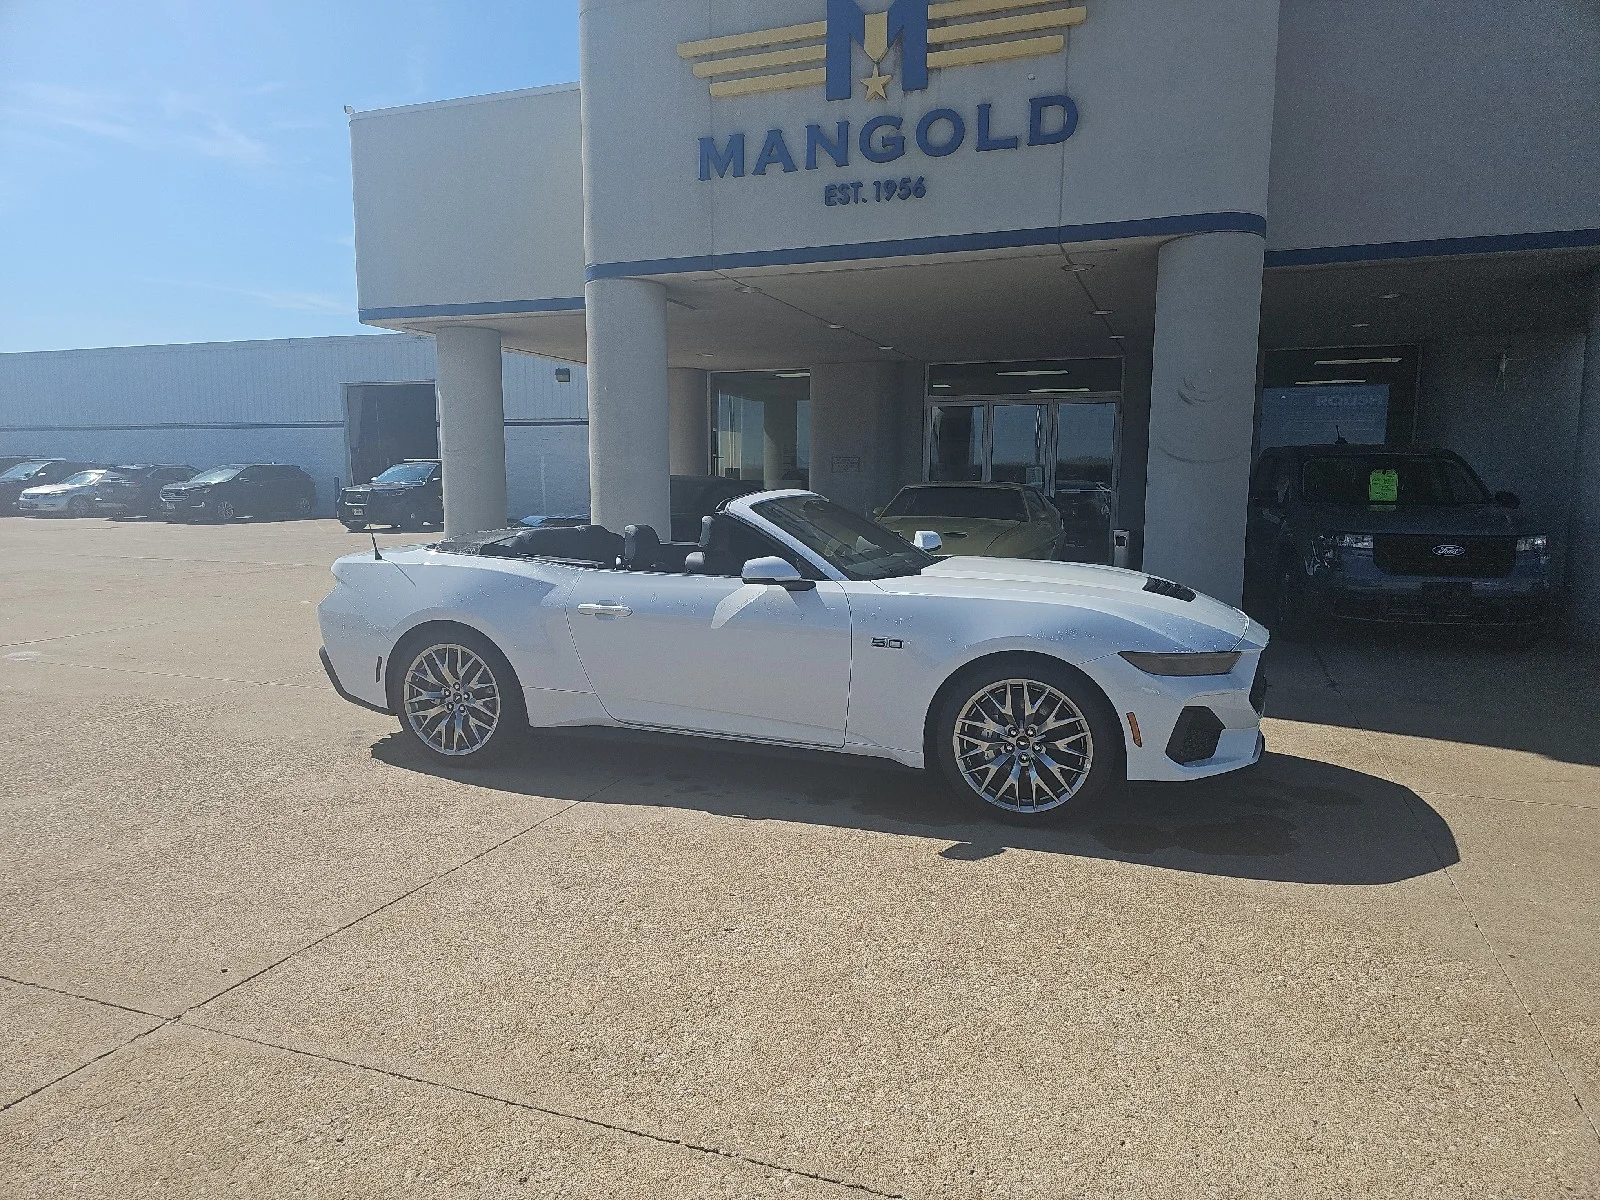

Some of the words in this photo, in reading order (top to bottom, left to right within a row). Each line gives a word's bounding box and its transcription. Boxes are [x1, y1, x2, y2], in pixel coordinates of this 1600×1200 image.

[698, 94, 1079, 182] MANGOLD
[824, 181, 868, 207] EST.
[873, 176, 927, 203] 1956
